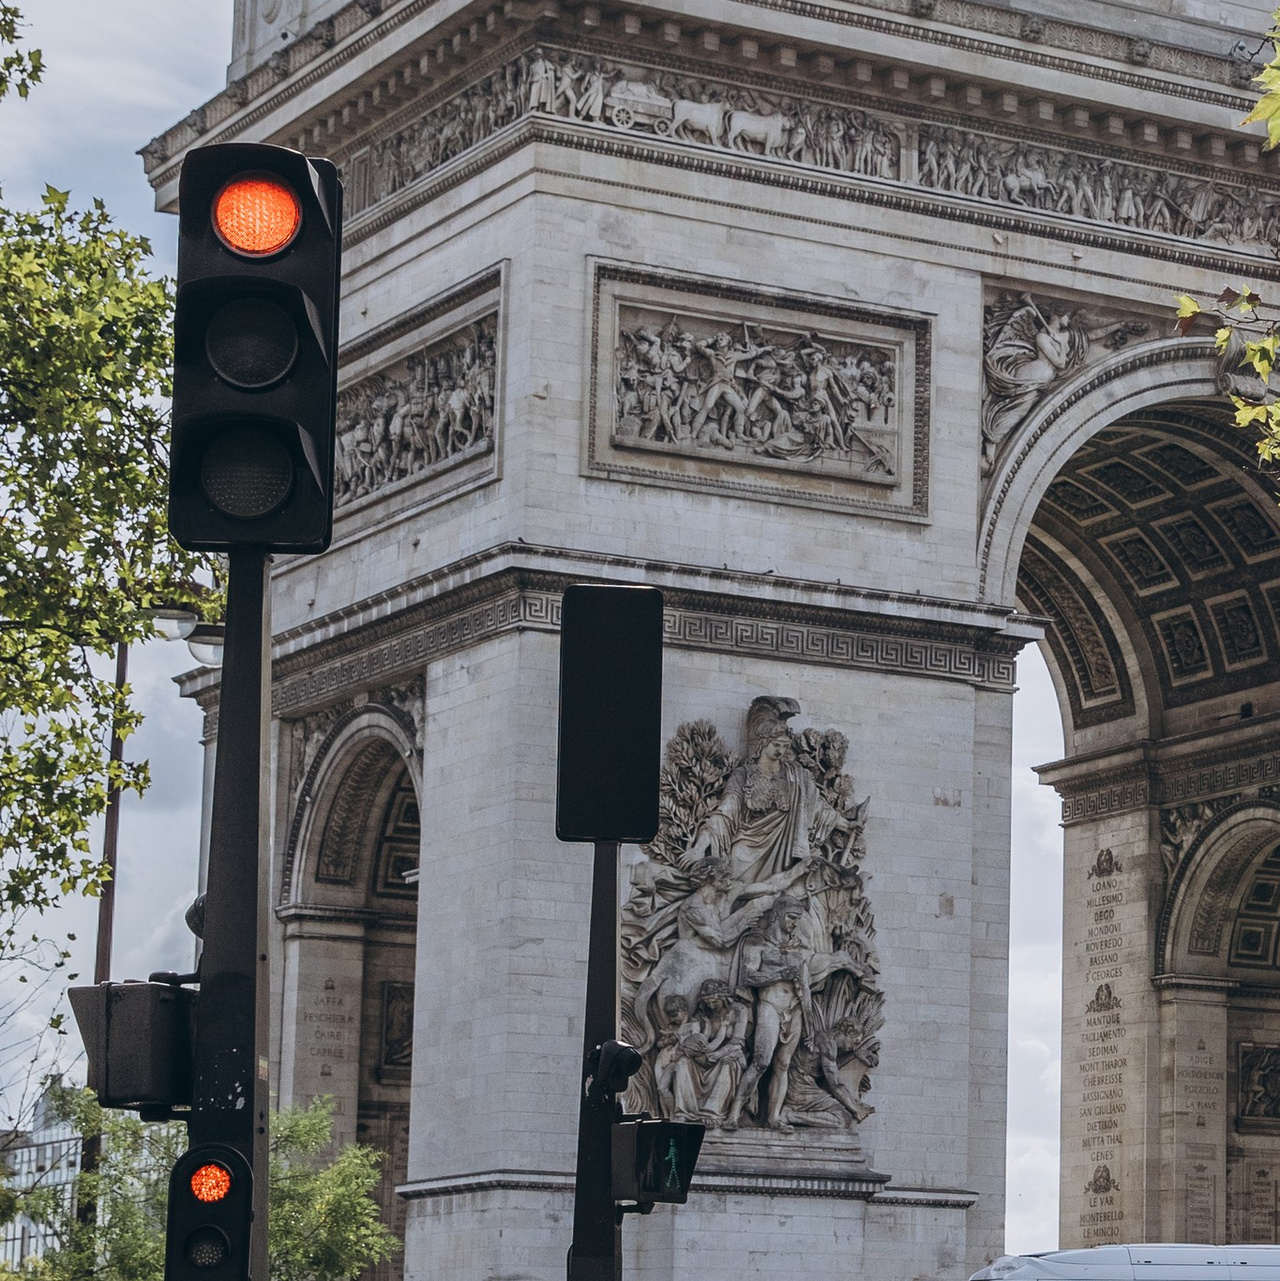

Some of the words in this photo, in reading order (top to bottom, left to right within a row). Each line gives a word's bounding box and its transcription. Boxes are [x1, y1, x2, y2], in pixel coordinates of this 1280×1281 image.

[1092, 878, 1118, 892] LOANO
[1086, 892, 1123, 908] MILLESIMO
[1094, 908, 1115, 922] DEGO
[1088, 922, 1122, 937] MONDOVI
[1085, 937, 1123, 953] ROVEREDO
[1089, 953, 1119, 967] BASSANO
[1092, 968, 1123, 981] GEORGES
[1086, 1013, 1120, 1027] MANTOUE
[1081, 1028, 1127, 1043] TAGLIAMENTO
[1088, 1044, 1118, 1057] SEDIMAN
[1079, 1061, 1100, 1074] MONT
[1101, 1058, 1128, 1072] THABOR
[1079, 1105, 1092, 1118] SAN
[1089, 1197, 1098, 1208] LE
[1099, 1196, 1114, 1207] VAR
[1079, 1210, 1124, 1224] MONTEBELLO
[1083, 1227, 1092, 1238] LE
[1093, 1226, 1119, 1237] MINCIO
